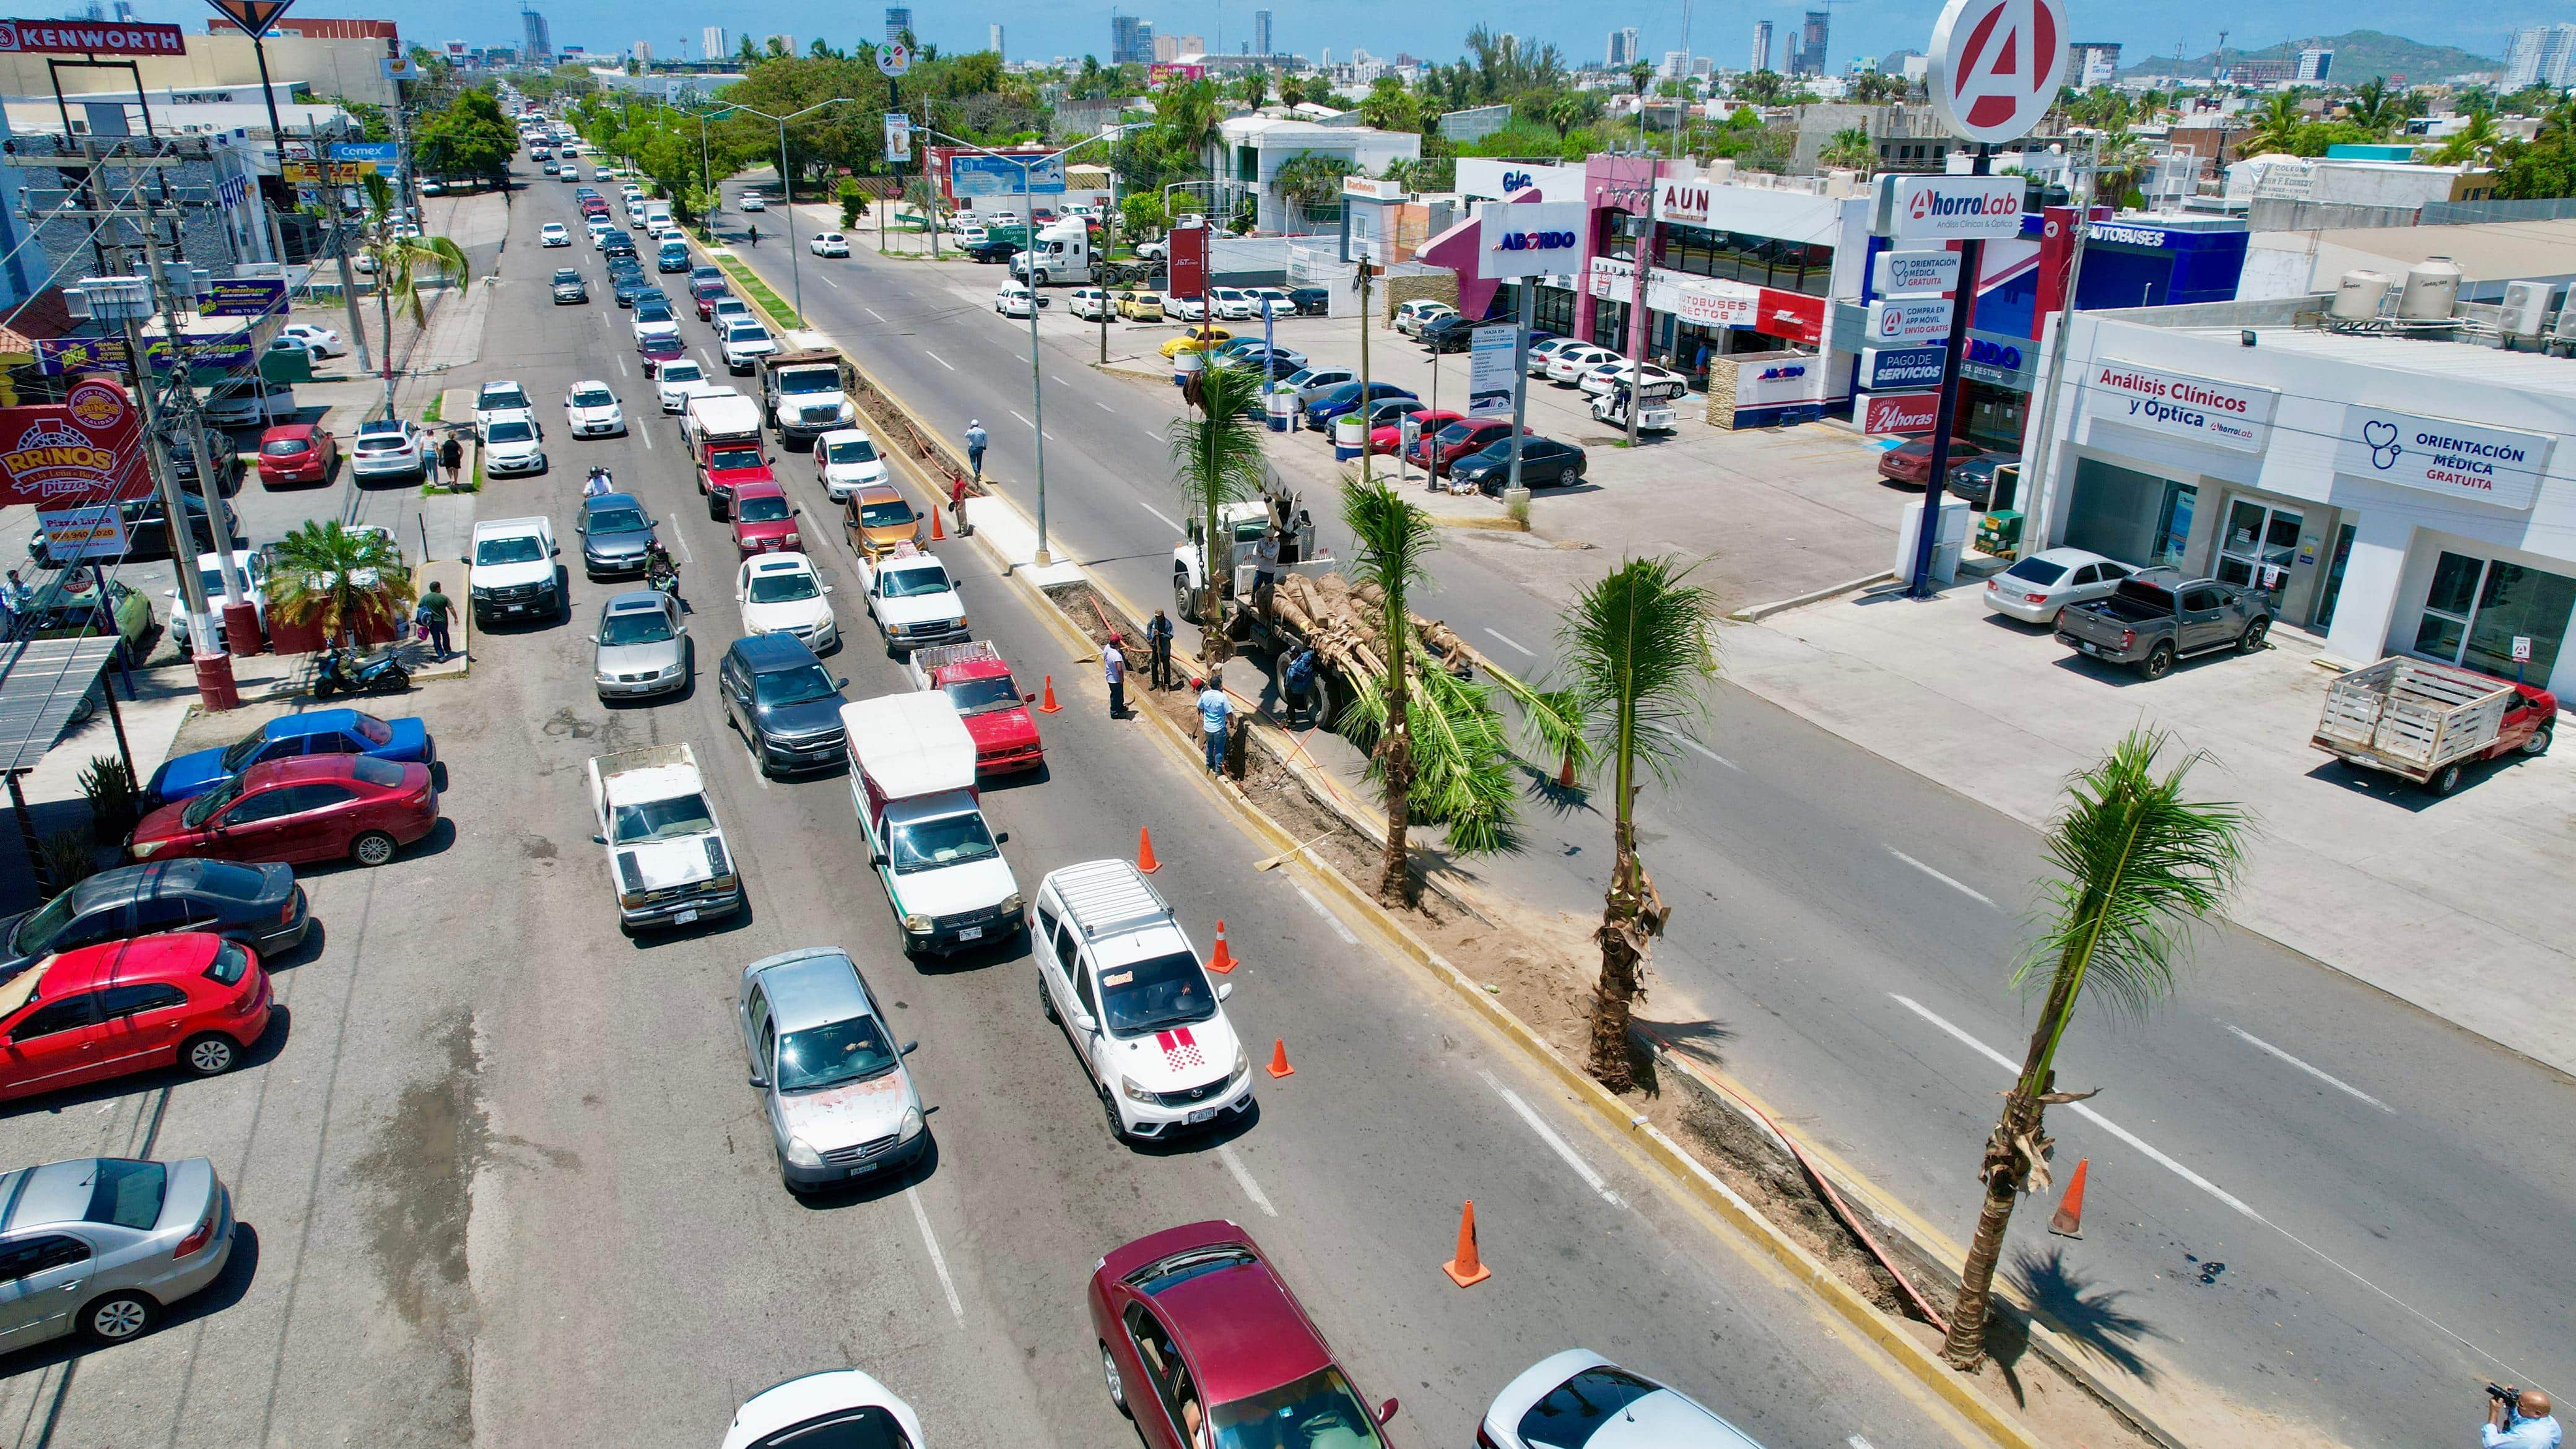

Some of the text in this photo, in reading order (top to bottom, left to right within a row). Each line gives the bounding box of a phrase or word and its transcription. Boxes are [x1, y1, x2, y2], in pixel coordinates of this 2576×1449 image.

[22, 28, 178, 49] KENWORTH
[341, 146, 384, 155] Comex
[1664, 185, 1708, 211] AUN
[1910, 189, 2017, 219] AhorroLab
[2089, 224, 2165, 246] AUTOBUSES
[1910, 259, 1957, 268] ORIENTACIÓN
[1908, 277, 1941, 286] GRATUITA
[1909, 269, 1935, 277] MÉDICA
[1920, 315, 1940, 323] MÓVIL
[1905, 324, 1949, 334] ENVÍO GRATIS
[61, 347, 87, 368] Takis
[1887, 354, 1932, 367] PAGO DE
[1876, 365, 1941, 381] SERVICIOS
[1974, 366, 2003, 379] DESTINO
[2100, 368, 2247, 412] Análisis Clínicos
[84, 416, 114, 425] CALIDAD
[2129, 396, 2204, 428] y Óptica
[2416, 433, 2525, 462] ORIENTACIÓN
[4, 447, 112, 474] RRINOS
[2433, 454, 2493, 475] MÉDICA
[2427, 469, 2492, 490] GRATUITA
[46, 519, 78, 528] Pizza
